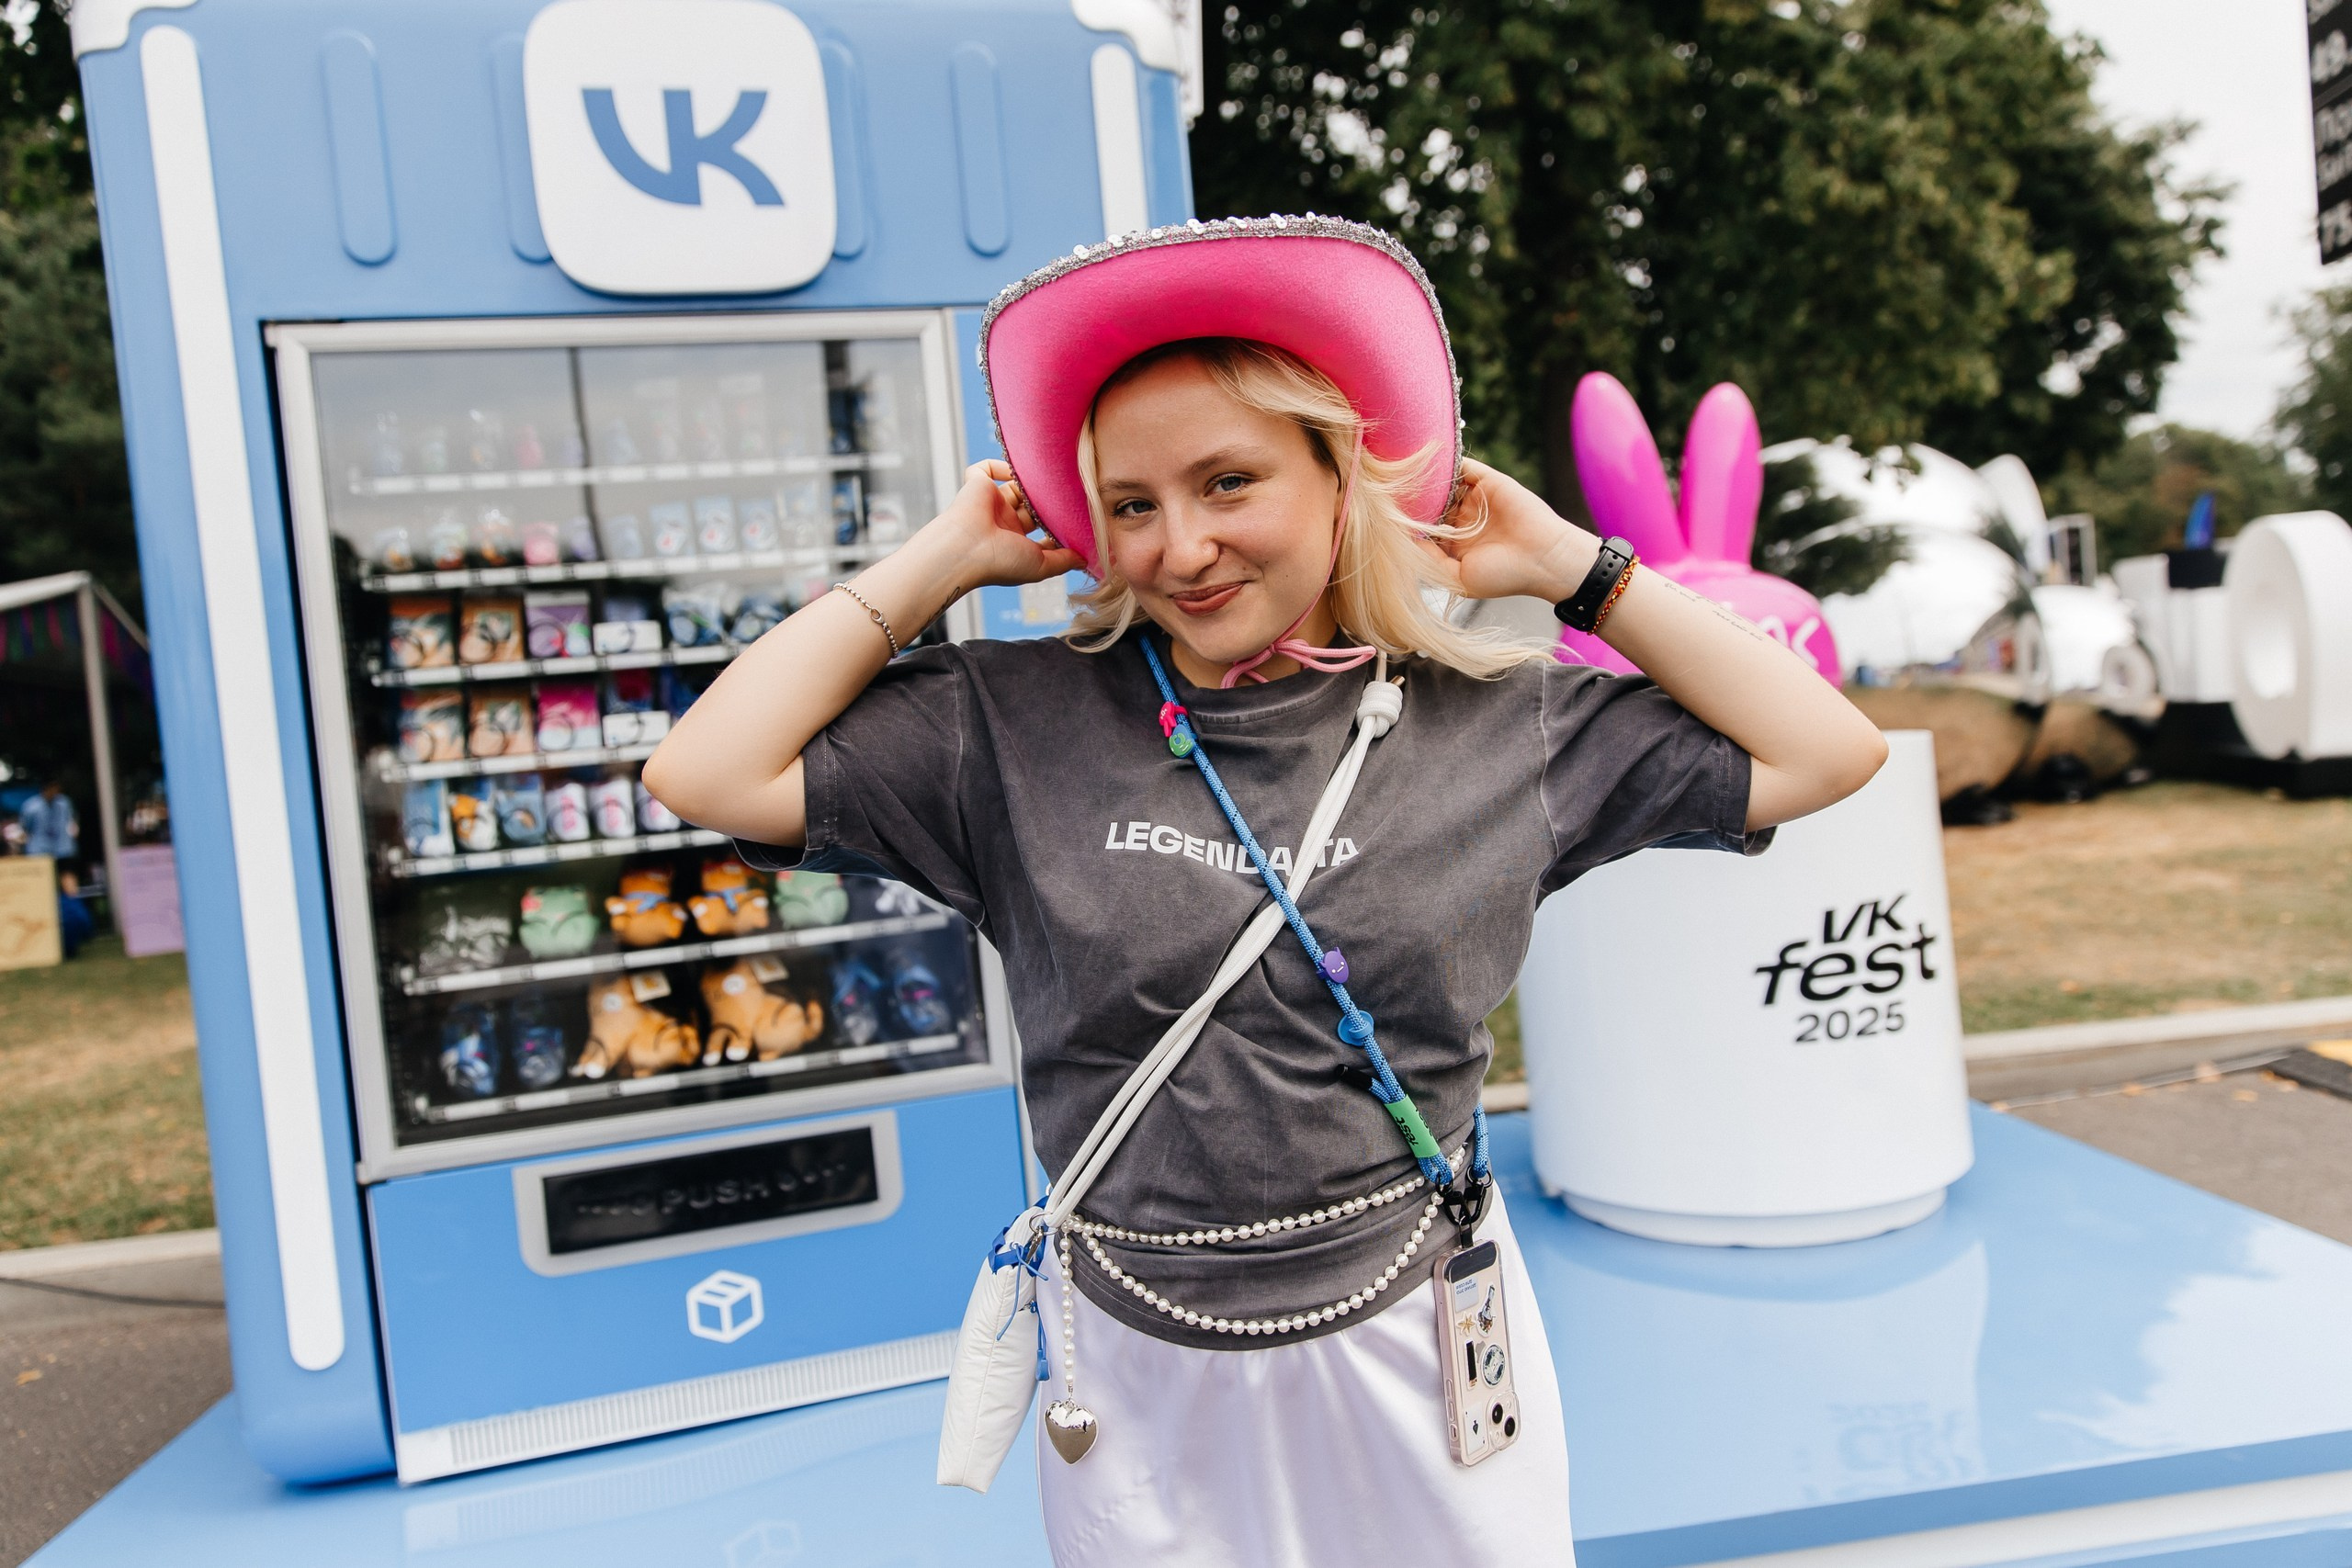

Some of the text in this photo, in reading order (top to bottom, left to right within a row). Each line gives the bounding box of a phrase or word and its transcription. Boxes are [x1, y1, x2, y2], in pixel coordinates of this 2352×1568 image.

[581, 88, 785, 206] VK
[1823, 895, 1905, 944] VK
[1756, 923, 1936, 1005] fest
[1796, 1002, 1904, 1042] 2025
[660, 1178, 770, 1214] PUSH
